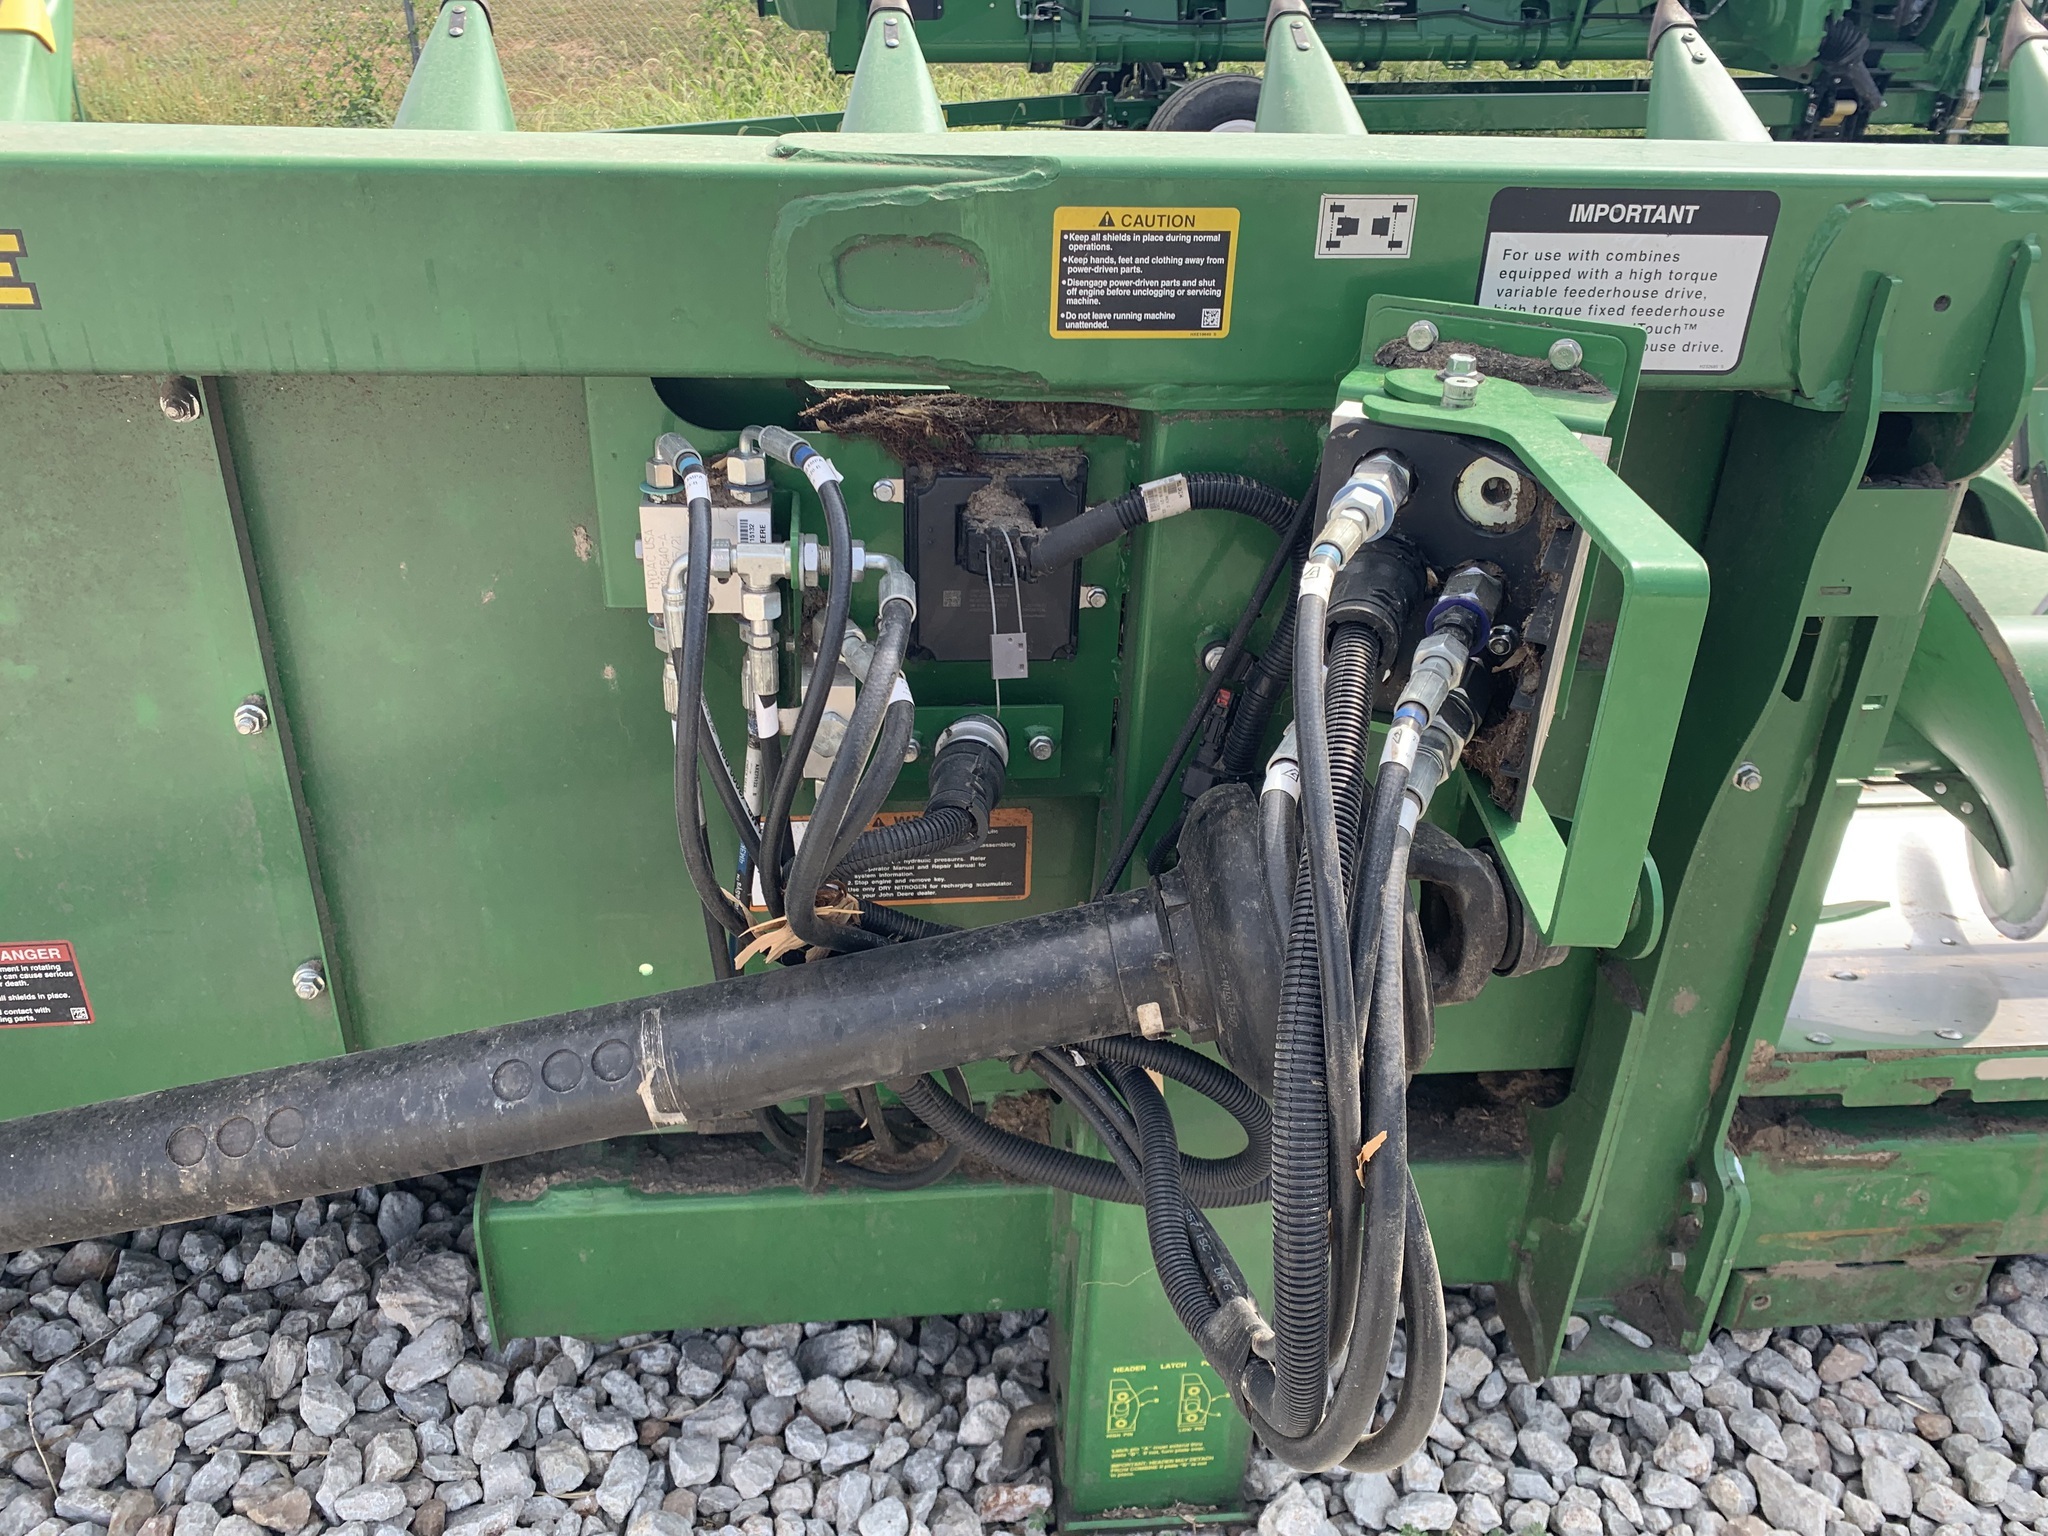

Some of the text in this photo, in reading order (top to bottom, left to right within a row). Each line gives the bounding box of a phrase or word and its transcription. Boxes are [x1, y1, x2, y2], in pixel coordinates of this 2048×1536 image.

[1569, 203, 1700, 224] IMPORTANT
[1121, 214, 1196, 227] CAUTION
[1069, 233, 1220, 243] Keep all shields in place during normal
[1068, 243, 1113, 251] operations.
[1068, 256, 1224, 266] Keep hands, feet and clothing away from
[1502, 249, 1680, 263] For use with combines
[1067, 266, 1142, 275] power-driven parts.
[1499, 268, 1718, 284] equipped with a high torque
[1067, 279, 1215, 288] Disengage power-driven parts and shut
[1066, 288, 1077, 296] off
[1079, 288, 1105, 298] engine
[1106, 288, 1131, 296] before
[1132, 288, 1175, 298] unclogging
[1186, 288, 1222, 297] servicing
[1496, 286, 1707, 301] variable feederhouse drive,
[1066, 297, 1101, 305] machine.
[1587, 304, 1625, 317] fixed
[1631, 305, 1725, 318] feederhouse
[1065, 312, 1175, 321] Do not leave running machine
[1065, 321, 1109, 329] unattended.
[1682, 342, 1724, 353] drive.
[644, 529, 658, 590] HYDAC USA
[0, 948, 61, 961] ANGER
[21, 964, 28, 972] in
[31, 964, 61, 972] rotating
[8, 993, 36, 1001] shields
[47, 992, 70, 1000] place.
[4, 1007, 33, 1015] contact
[14, 1015, 36, 1023] parts.
[1113, 1362, 1187, 1373] HEADER LATCH
